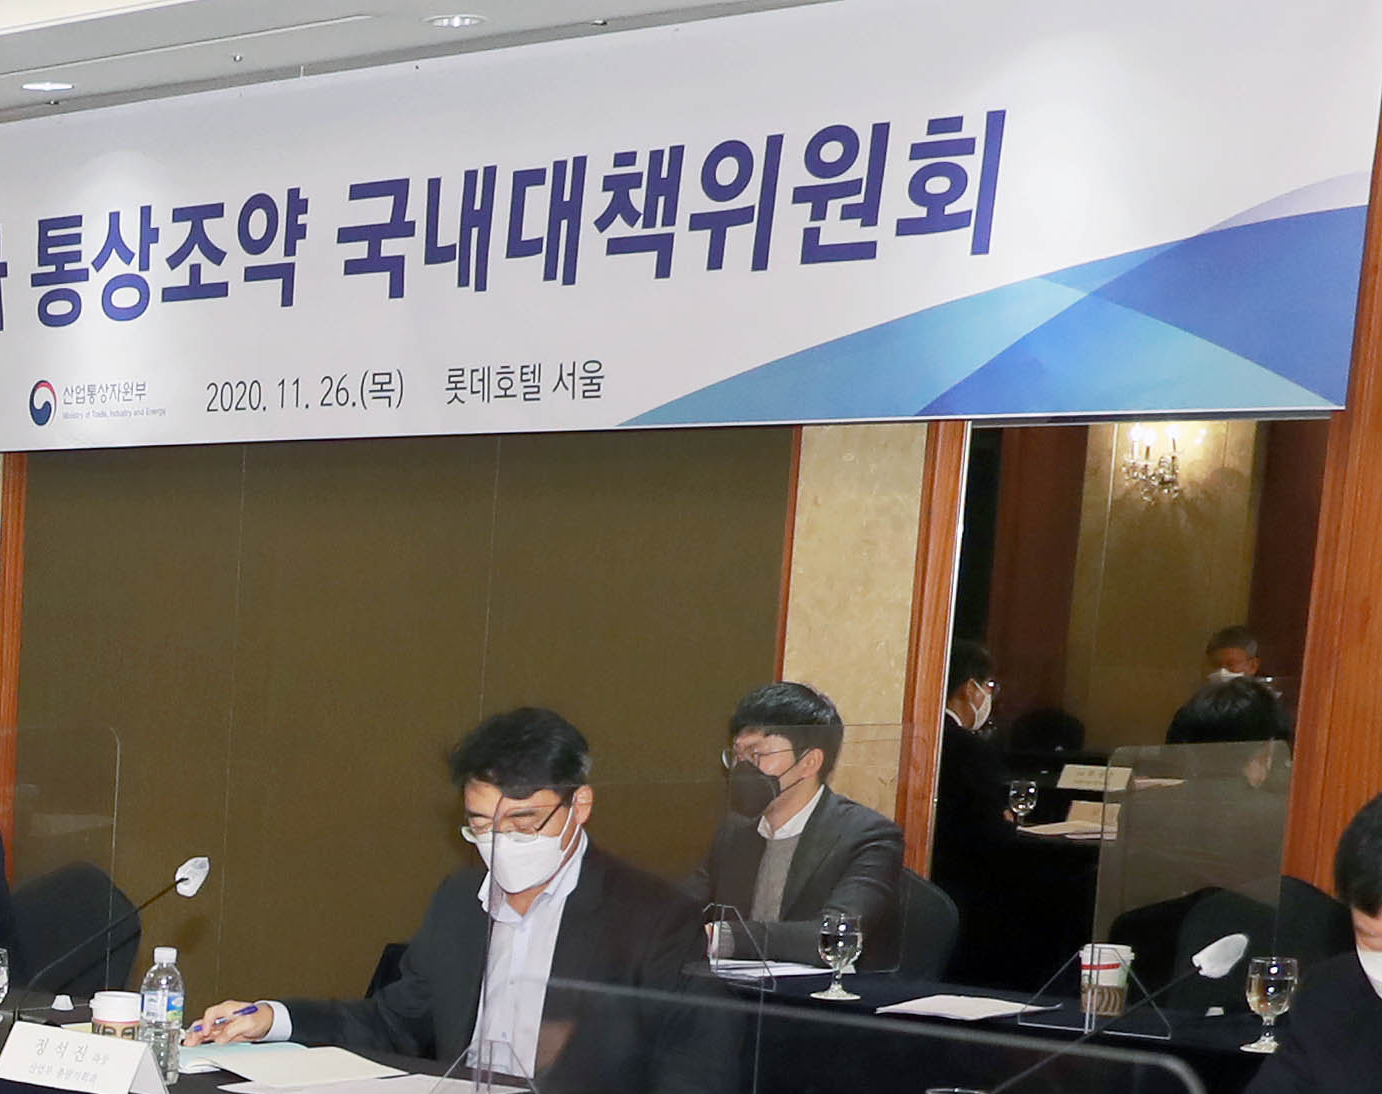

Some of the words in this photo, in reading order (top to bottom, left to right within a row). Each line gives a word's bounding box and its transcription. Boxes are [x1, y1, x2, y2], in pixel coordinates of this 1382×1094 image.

[29, 186, 309, 328] 통상조약
[336, 108, 1007, 299] 국내대책위원회
[62, 380, 147, 405] 산업통상자원부
[206, 379, 267, 412] 2020.
[277, 377, 309, 409] 11.
[319, 368, 404, 411] 26.(목)
[444, 362, 542, 406] 롯데호텔
[552, 359, 605, 401] 서울
